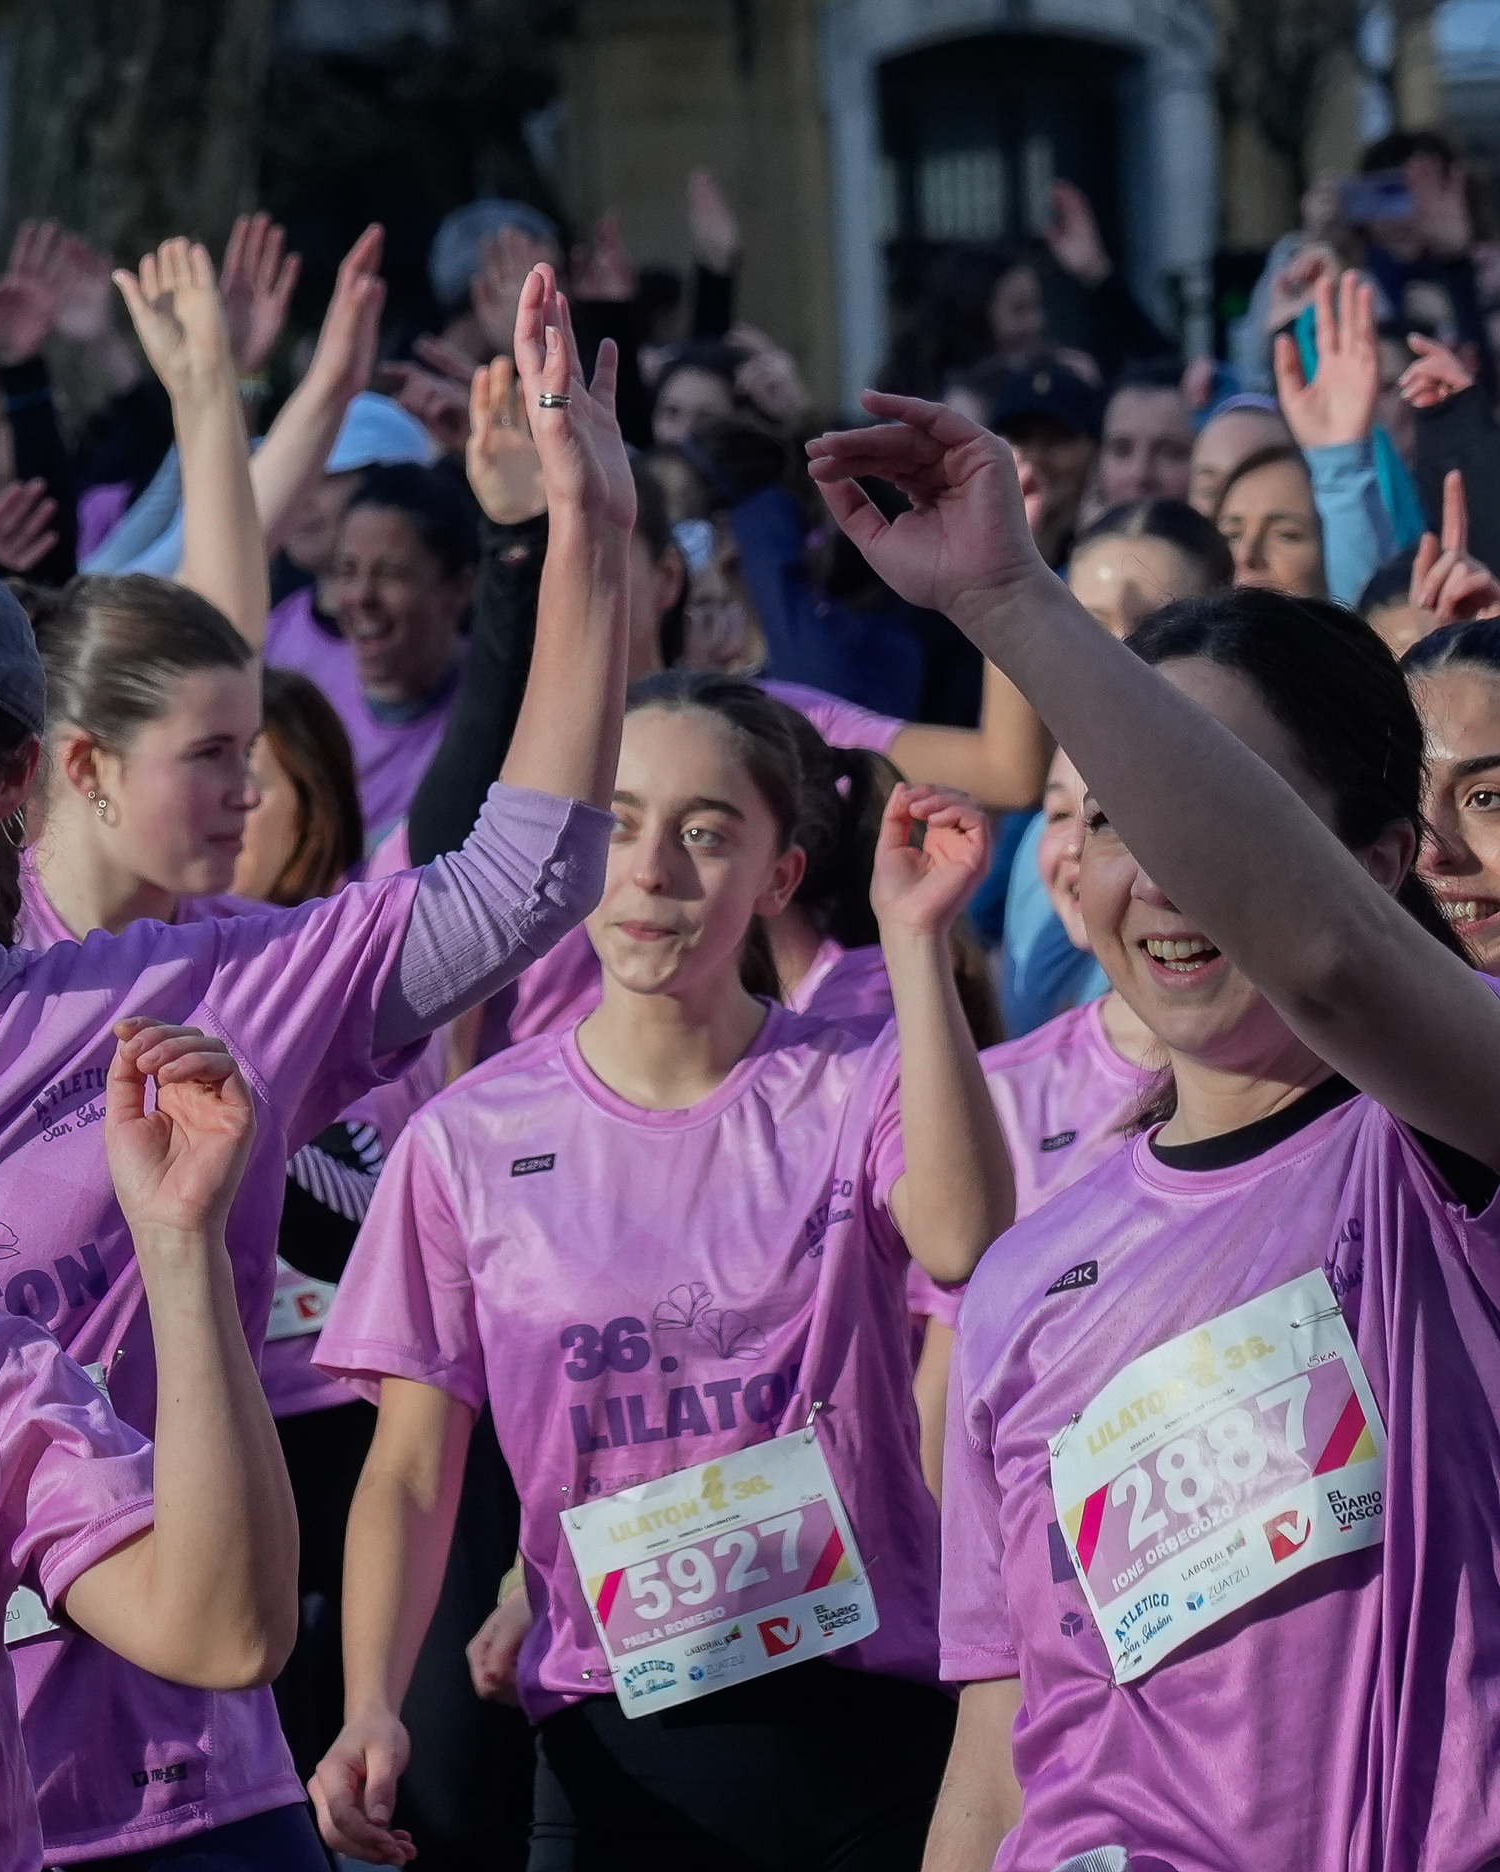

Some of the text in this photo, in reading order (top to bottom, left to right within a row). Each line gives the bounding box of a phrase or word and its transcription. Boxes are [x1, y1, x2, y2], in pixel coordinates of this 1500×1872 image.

[33, 1067, 107, 1123] ATLETI
[43, 1117, 72, 1142] San
[560, 1316, 679, 1382] 36.
[1306, 1350, 1338, 1368] 5KM
[1111, 1374, 1313, 1552] 2887
[1326, 1489, 1347, 1504] EL
[1331, 1490, 1382, 1516] DIARIO
[608, 1500, 699, 1544] LILATON
[1335, 1503, 1384, 1526] VASCO
[625, 1508, 806, 1621] 5927
[1111, 1504, 1235, 1593] IONE ORBEGOZO
[1181, 1550, 1225, 1582] LABORAL
[1208, 1565, 1251, 1600] ZUATZU
[813, 1604, 830, 1615] EL
[816, 1603, 860, 1625] DIARIO
[820, 1612, 862, 1633] VASCO
[1115, 1591, 1170, 1643] ATLETICO
[621, 1605, 728, 1650] PAULA ROMERO
[1122, 1613, 1174, 1656] San Sebastian
[622, 1659, 675, 1688] ATLETICO
